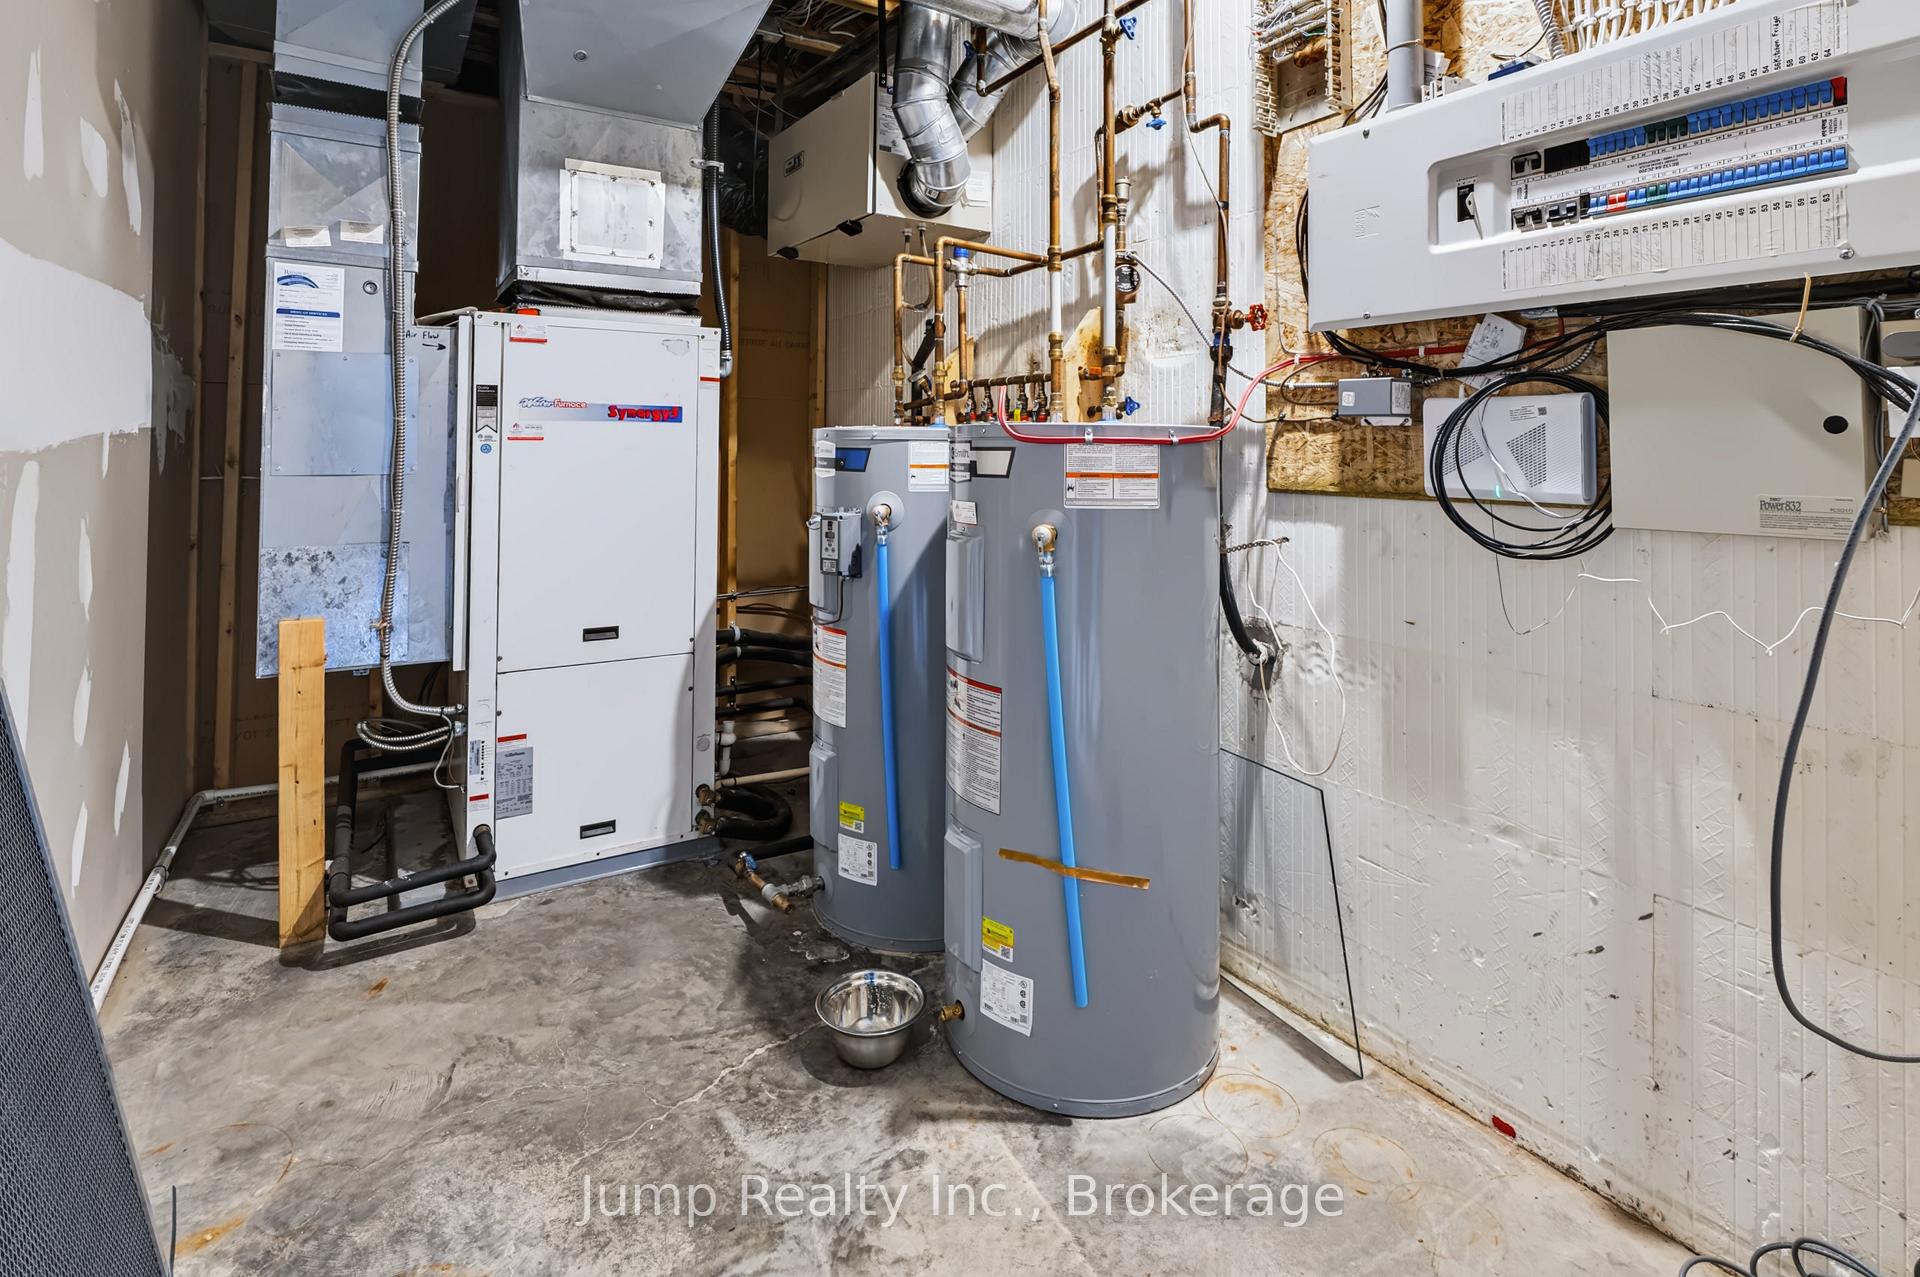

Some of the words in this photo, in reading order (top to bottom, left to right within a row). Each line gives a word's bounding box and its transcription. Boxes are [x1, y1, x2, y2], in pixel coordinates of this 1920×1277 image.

[1772, 15, 1781, 37] Fridge
[1773, 40, 1781, 62] Kitchen
[1823, 48, 1832, 57] 64
[1798, 55, 1806, 65] 60
[1811, 52, 1819, 61] 62
[1786, 58, 1794, 68] 58
[1750, 68, 1758, 77] 52
[1762, 65, 1770, 74] 54
[1727, 74, 1735, 83] 48
[1739, 71, 1746, 80] 50
[1705, 80, 1712, 88] 44
[1716, 77, 1723, 85] 46
[1684, 86, 1690, 94] 40
[1694, 83, 1701, 92] 42
[1673, 89, 1680, 97] 38
[1652, 95, 1659, 103] 34
[1623, 103, 1629, 111] 28
[1633, 100, 1639, 108] 30
[1604, 108, 1610, 116] 24
[1797, 198, 1805, 207] 59
[1810, 196, 1818, 205] 61
[1822, 193, 1831, 203] 63
[1761, 204, 1769, 213] 53
[1773, 201, 1781, 211] 55
[1785, 200, 1793, 209] 57
[1726, 210, 1734, 218] 47
[1737, 208, 1745, 216] 49
[1749, 206, 1757, 215] 51
[1694, 216, 1700, 224] 41
[1704, 213, 1712, 222] 43
[1715, 212, 1722, 220] 45
[1662, 221, 1669, 229] 35
[1683, 217, 1690, 226] 39
[1632, 226, 1639, 234] 29
[1652, 222, 1659, 231] 33
[1604, 231, 1610, 239] 23
[1613, 229, 1620, 237] 25
[1623, 228, 1629, 236] 27
[1551, 240, 1556, 248] 11
[1559, 238, 1565, 246] 13
[1568, 237, 1574, 245] 15
[405, 330, 417, 338] Air
[423, 331, 439, 339] Flow
[1760, 500, 1801, 512] Power832
